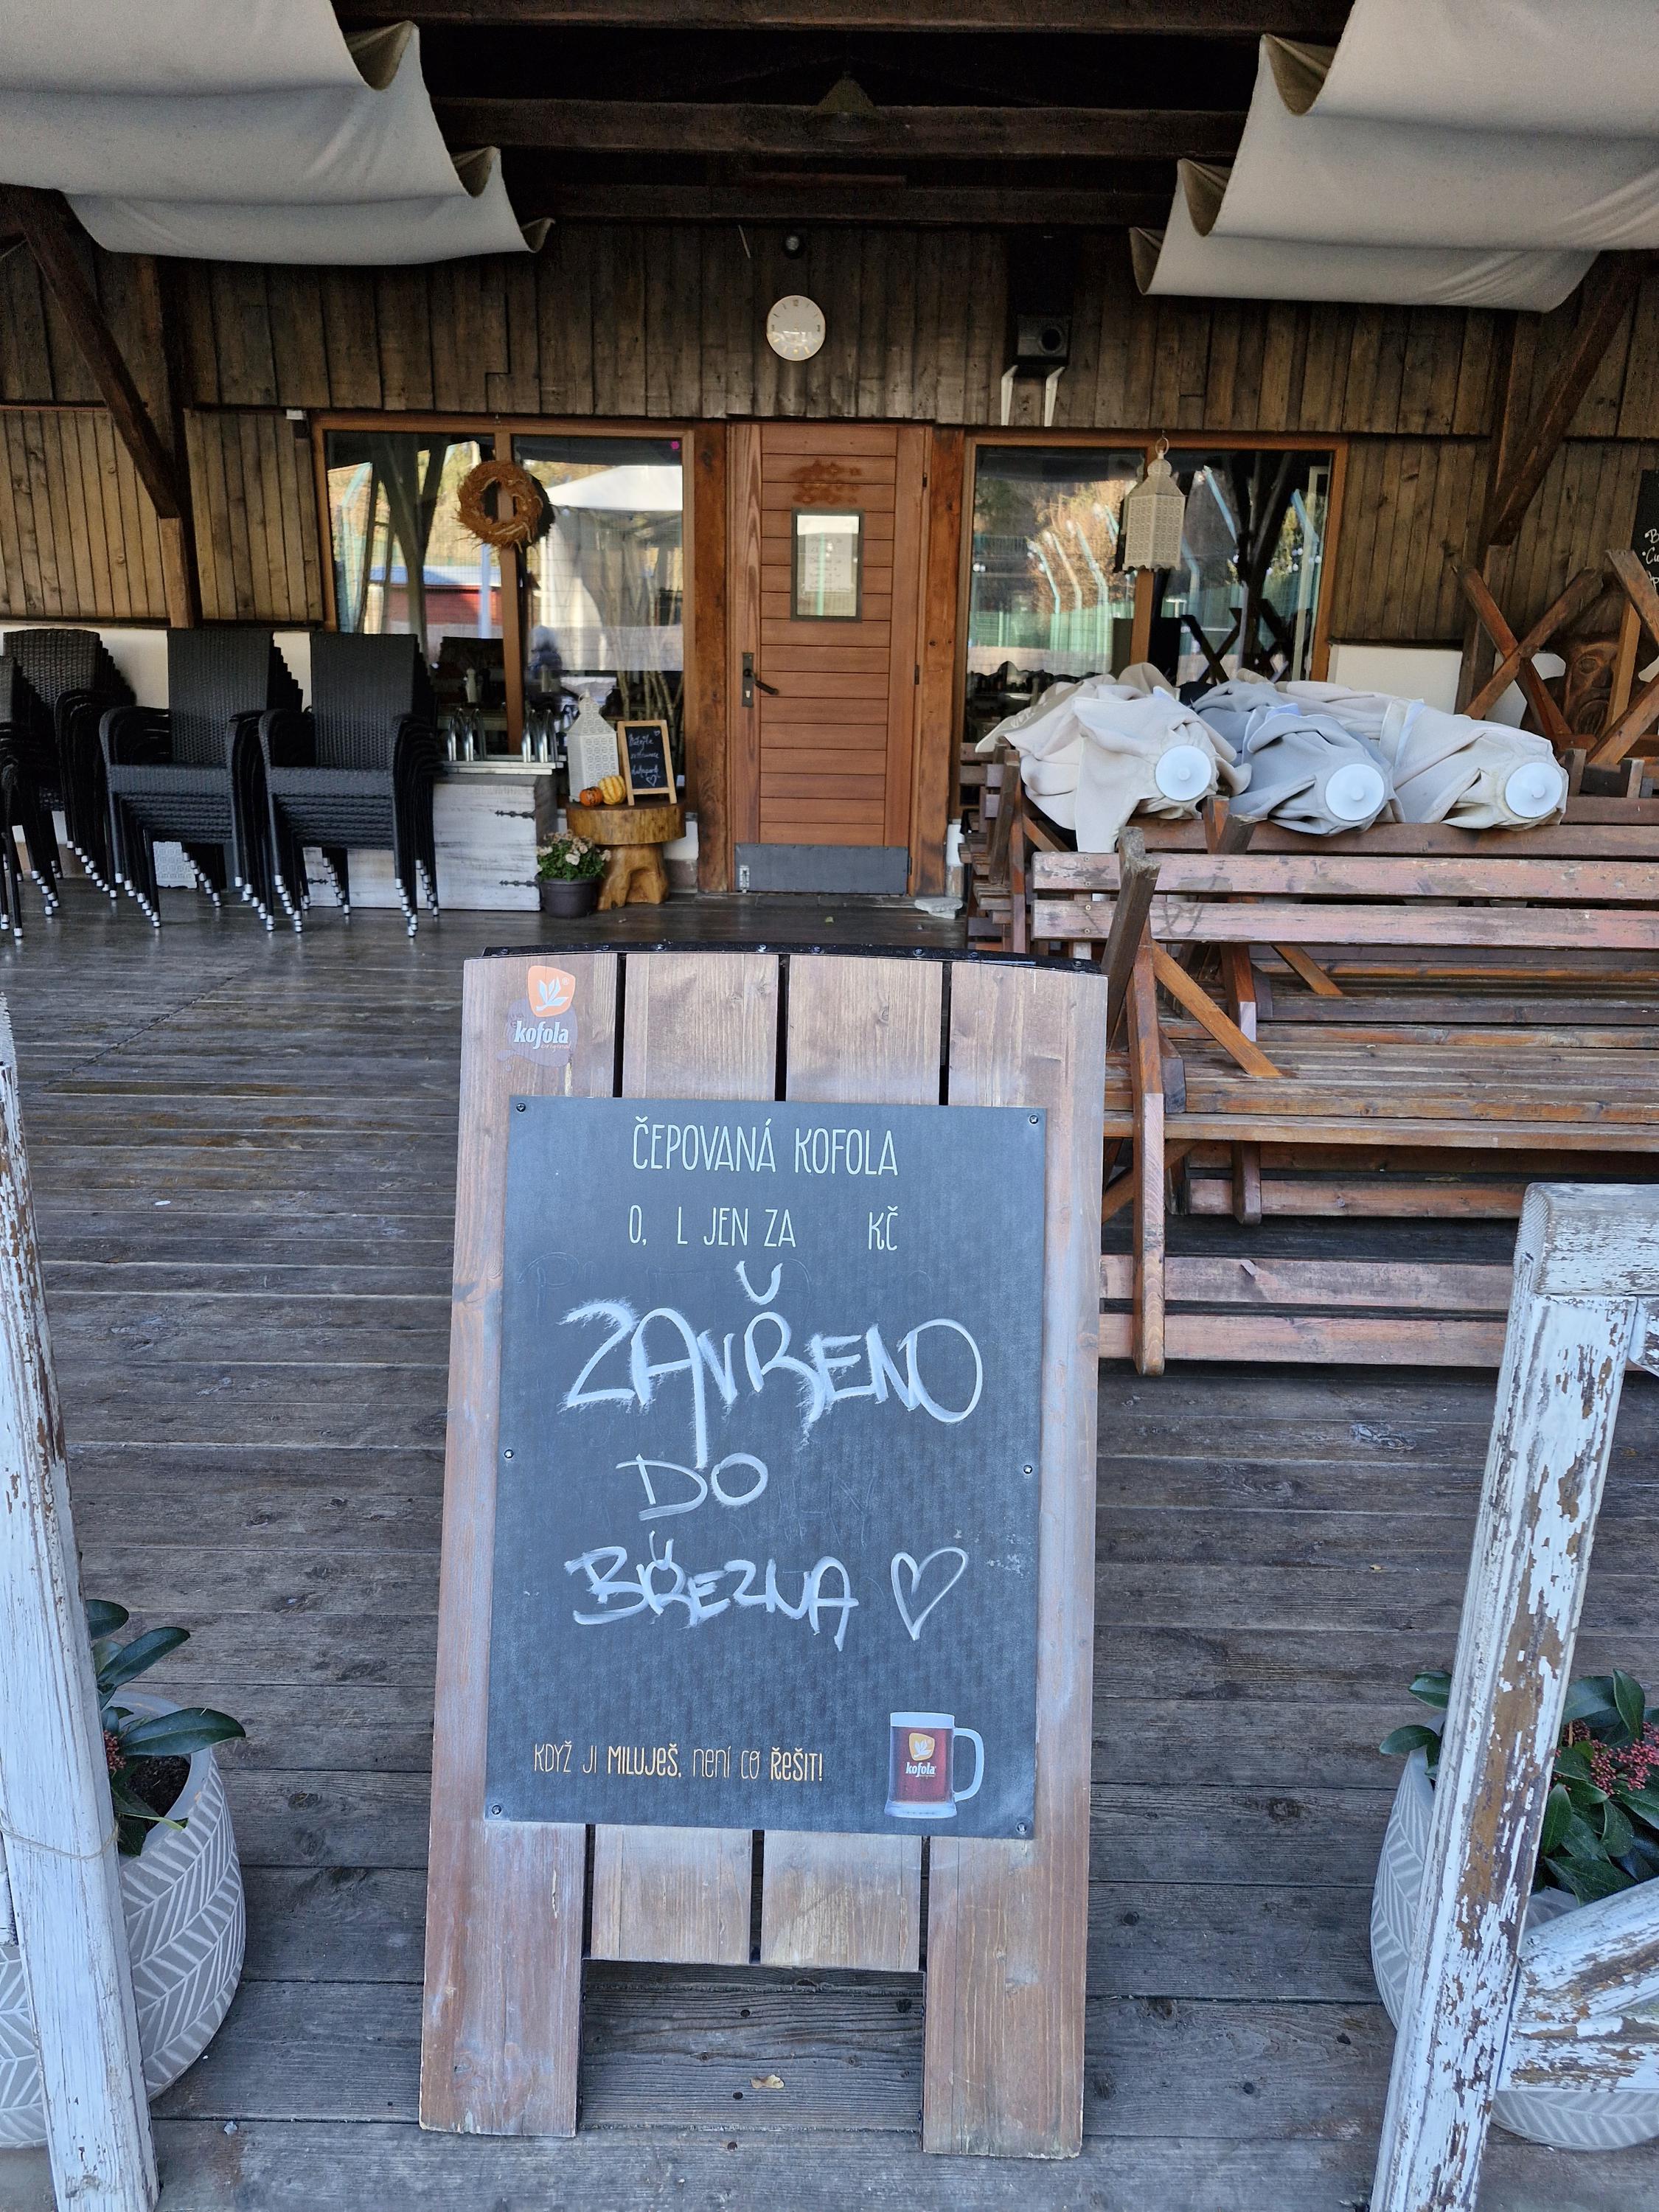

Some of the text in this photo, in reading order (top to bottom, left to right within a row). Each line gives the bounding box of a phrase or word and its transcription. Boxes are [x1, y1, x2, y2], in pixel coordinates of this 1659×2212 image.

[512, 1020, 568, 1051] kofola
[633, 1116, 898, 1176] ČEPOVANÁ KOFOLA
[677, 1206, 689, 1245] L
[703, 1207, 749, 1247] JEN
[763, 1208, 796, 1248] ZA
[868, 1205, 899, 1251] KČ
[558, 1260, 984, 1469] ZAVŘENO
[616, 1452, 768, 1520] DO
[563, 1530, 860, 1652] BŘEZNA
[534, 1739, 573, 1773] KDYŽ
[582, 1745, 597, 1774] JI
[905, 1761, 936, 1778] kofola
